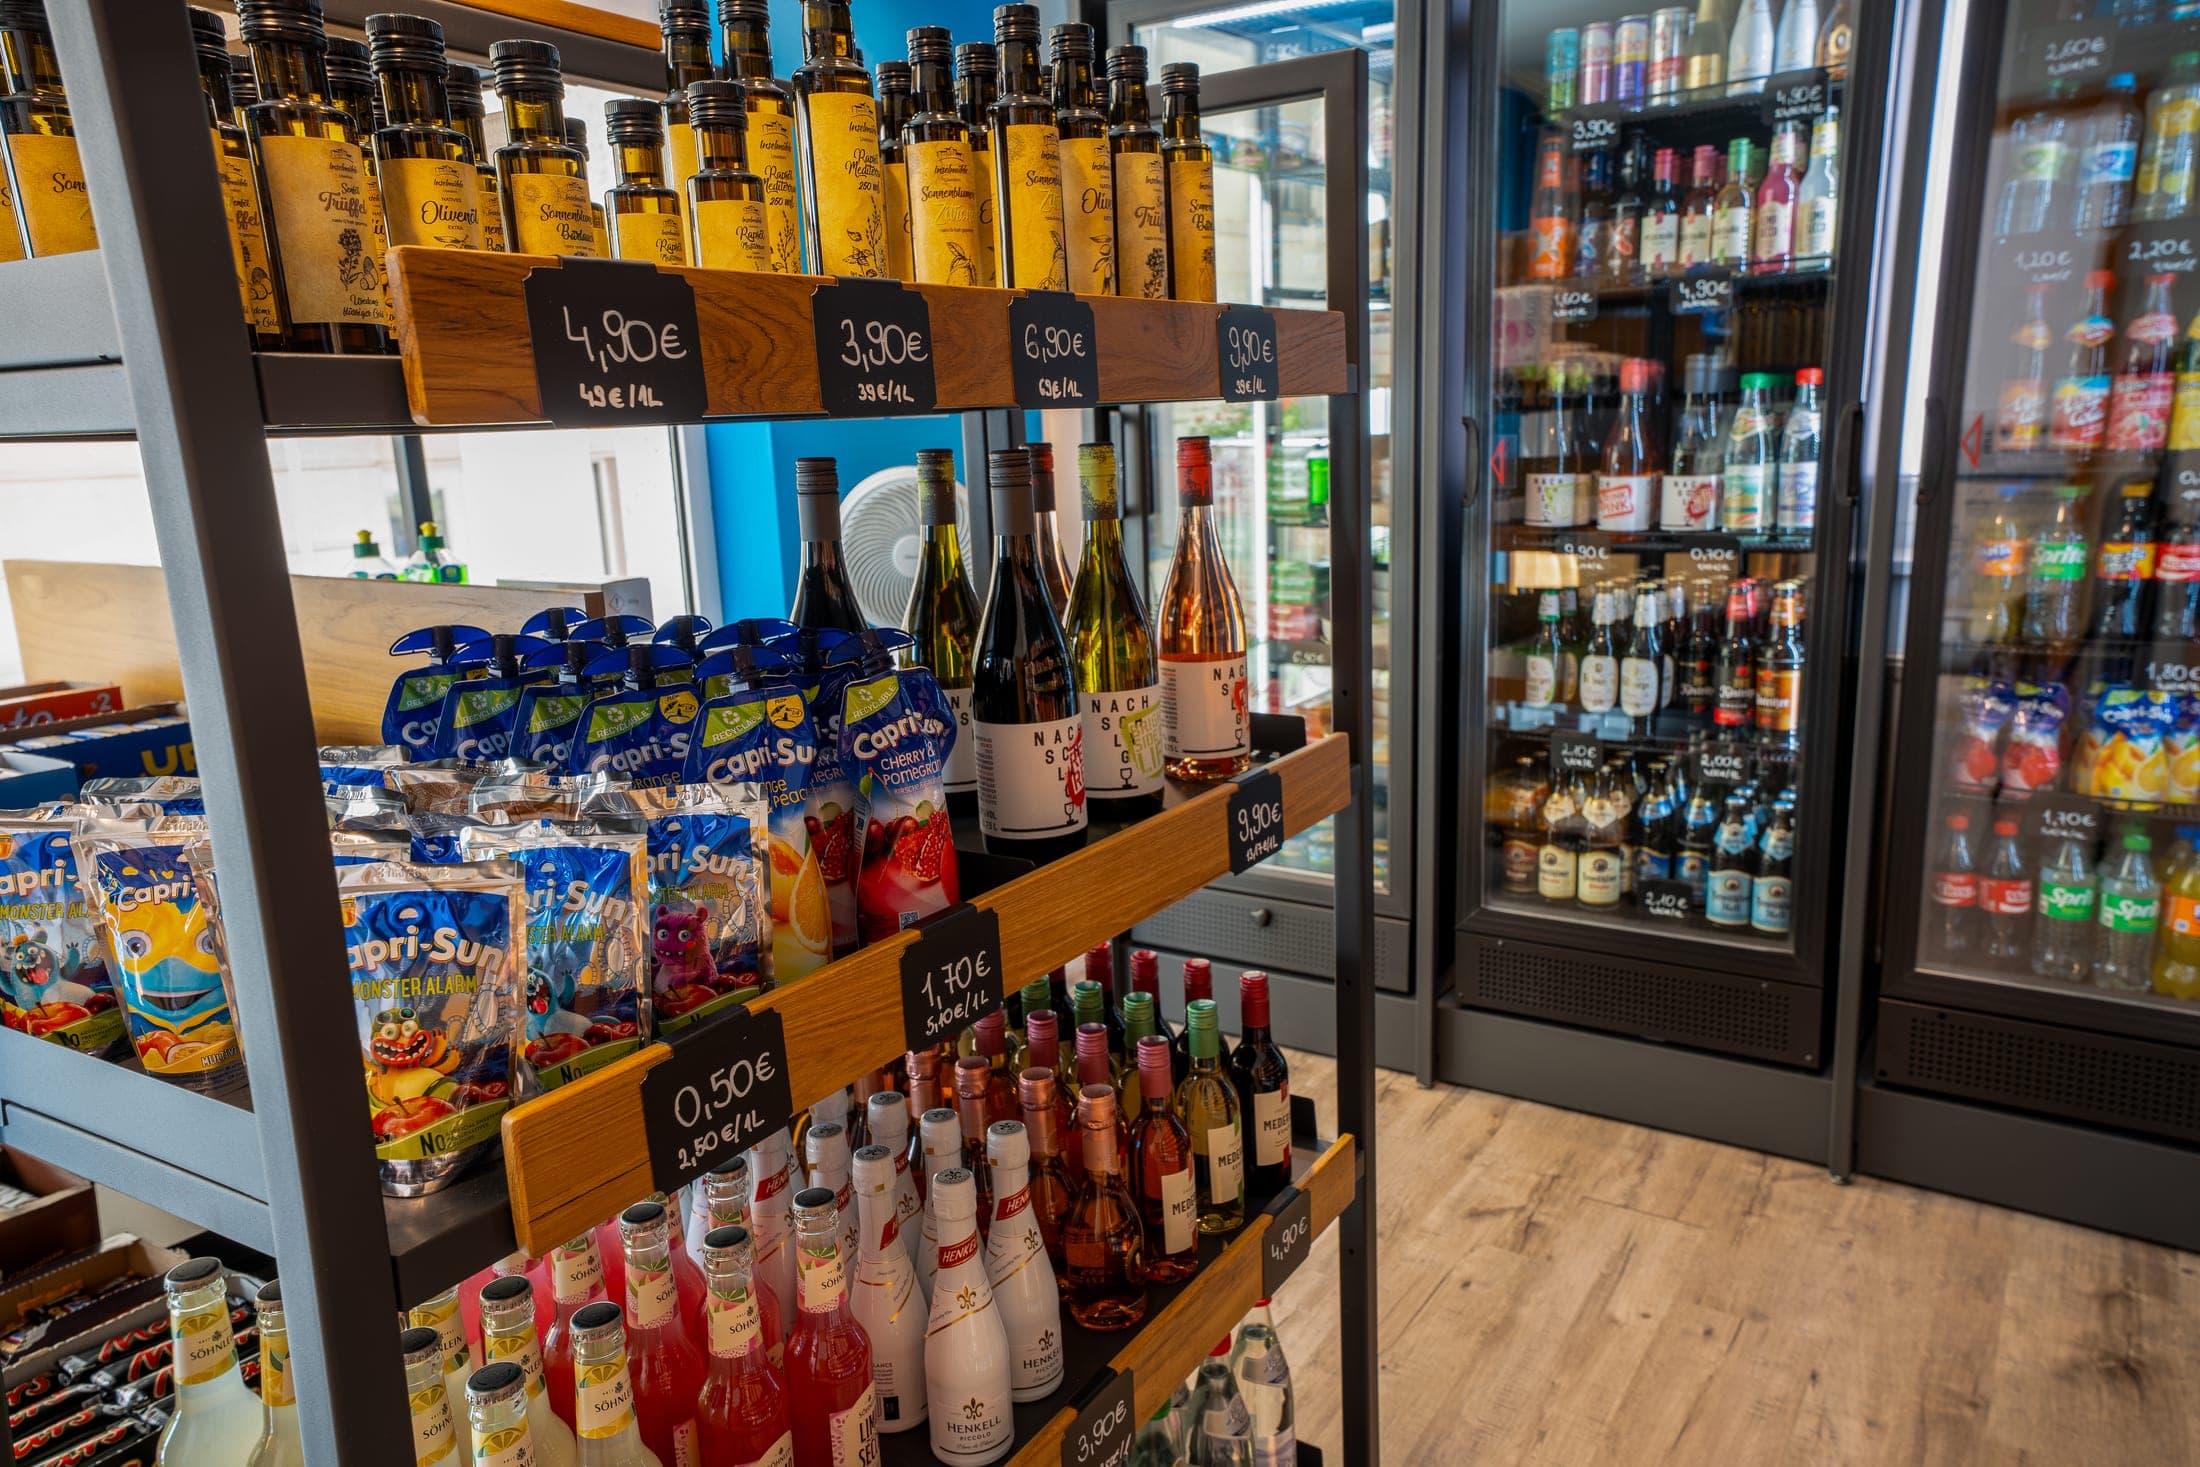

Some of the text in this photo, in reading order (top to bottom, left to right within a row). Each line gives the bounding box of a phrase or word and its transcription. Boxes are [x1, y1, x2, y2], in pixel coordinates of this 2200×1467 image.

[421, 200, 478, 225] Olivenöl
[563, 305, 688, 373] 4,90€
[840, 318, 929, 373] 3,90€
[1024, 323, 1086, 364] 6,90€
[1228, 326, 1275, 372] 9,90€
[592, 732, 689, 776] Capri-S
[707, 738, 815, 784] Capri-Su
[1238, 803, 1282, 842] 9,90€
[117, 875, 198, 912] Capri-
[687, 882, 730, 900] ALARM
[349, 925, 505, 972] apri-Sun
[561, 925, 605, 943] ALARM
[426, 975, 477, 996] ALARM
[922, 950, 992, 1010] 1,70€
[675, 1052, 776, 1128] 0,50€
[1271, 1216, 1308, 1261] 4,90€
[13, 1405, 95, 1459] ars
[946, 1416, 1002, 1434] HENKELL
[959, 1431, 992, 1441] PICCOLO
[1077, 1399, 1127, 1463] 3,90€
